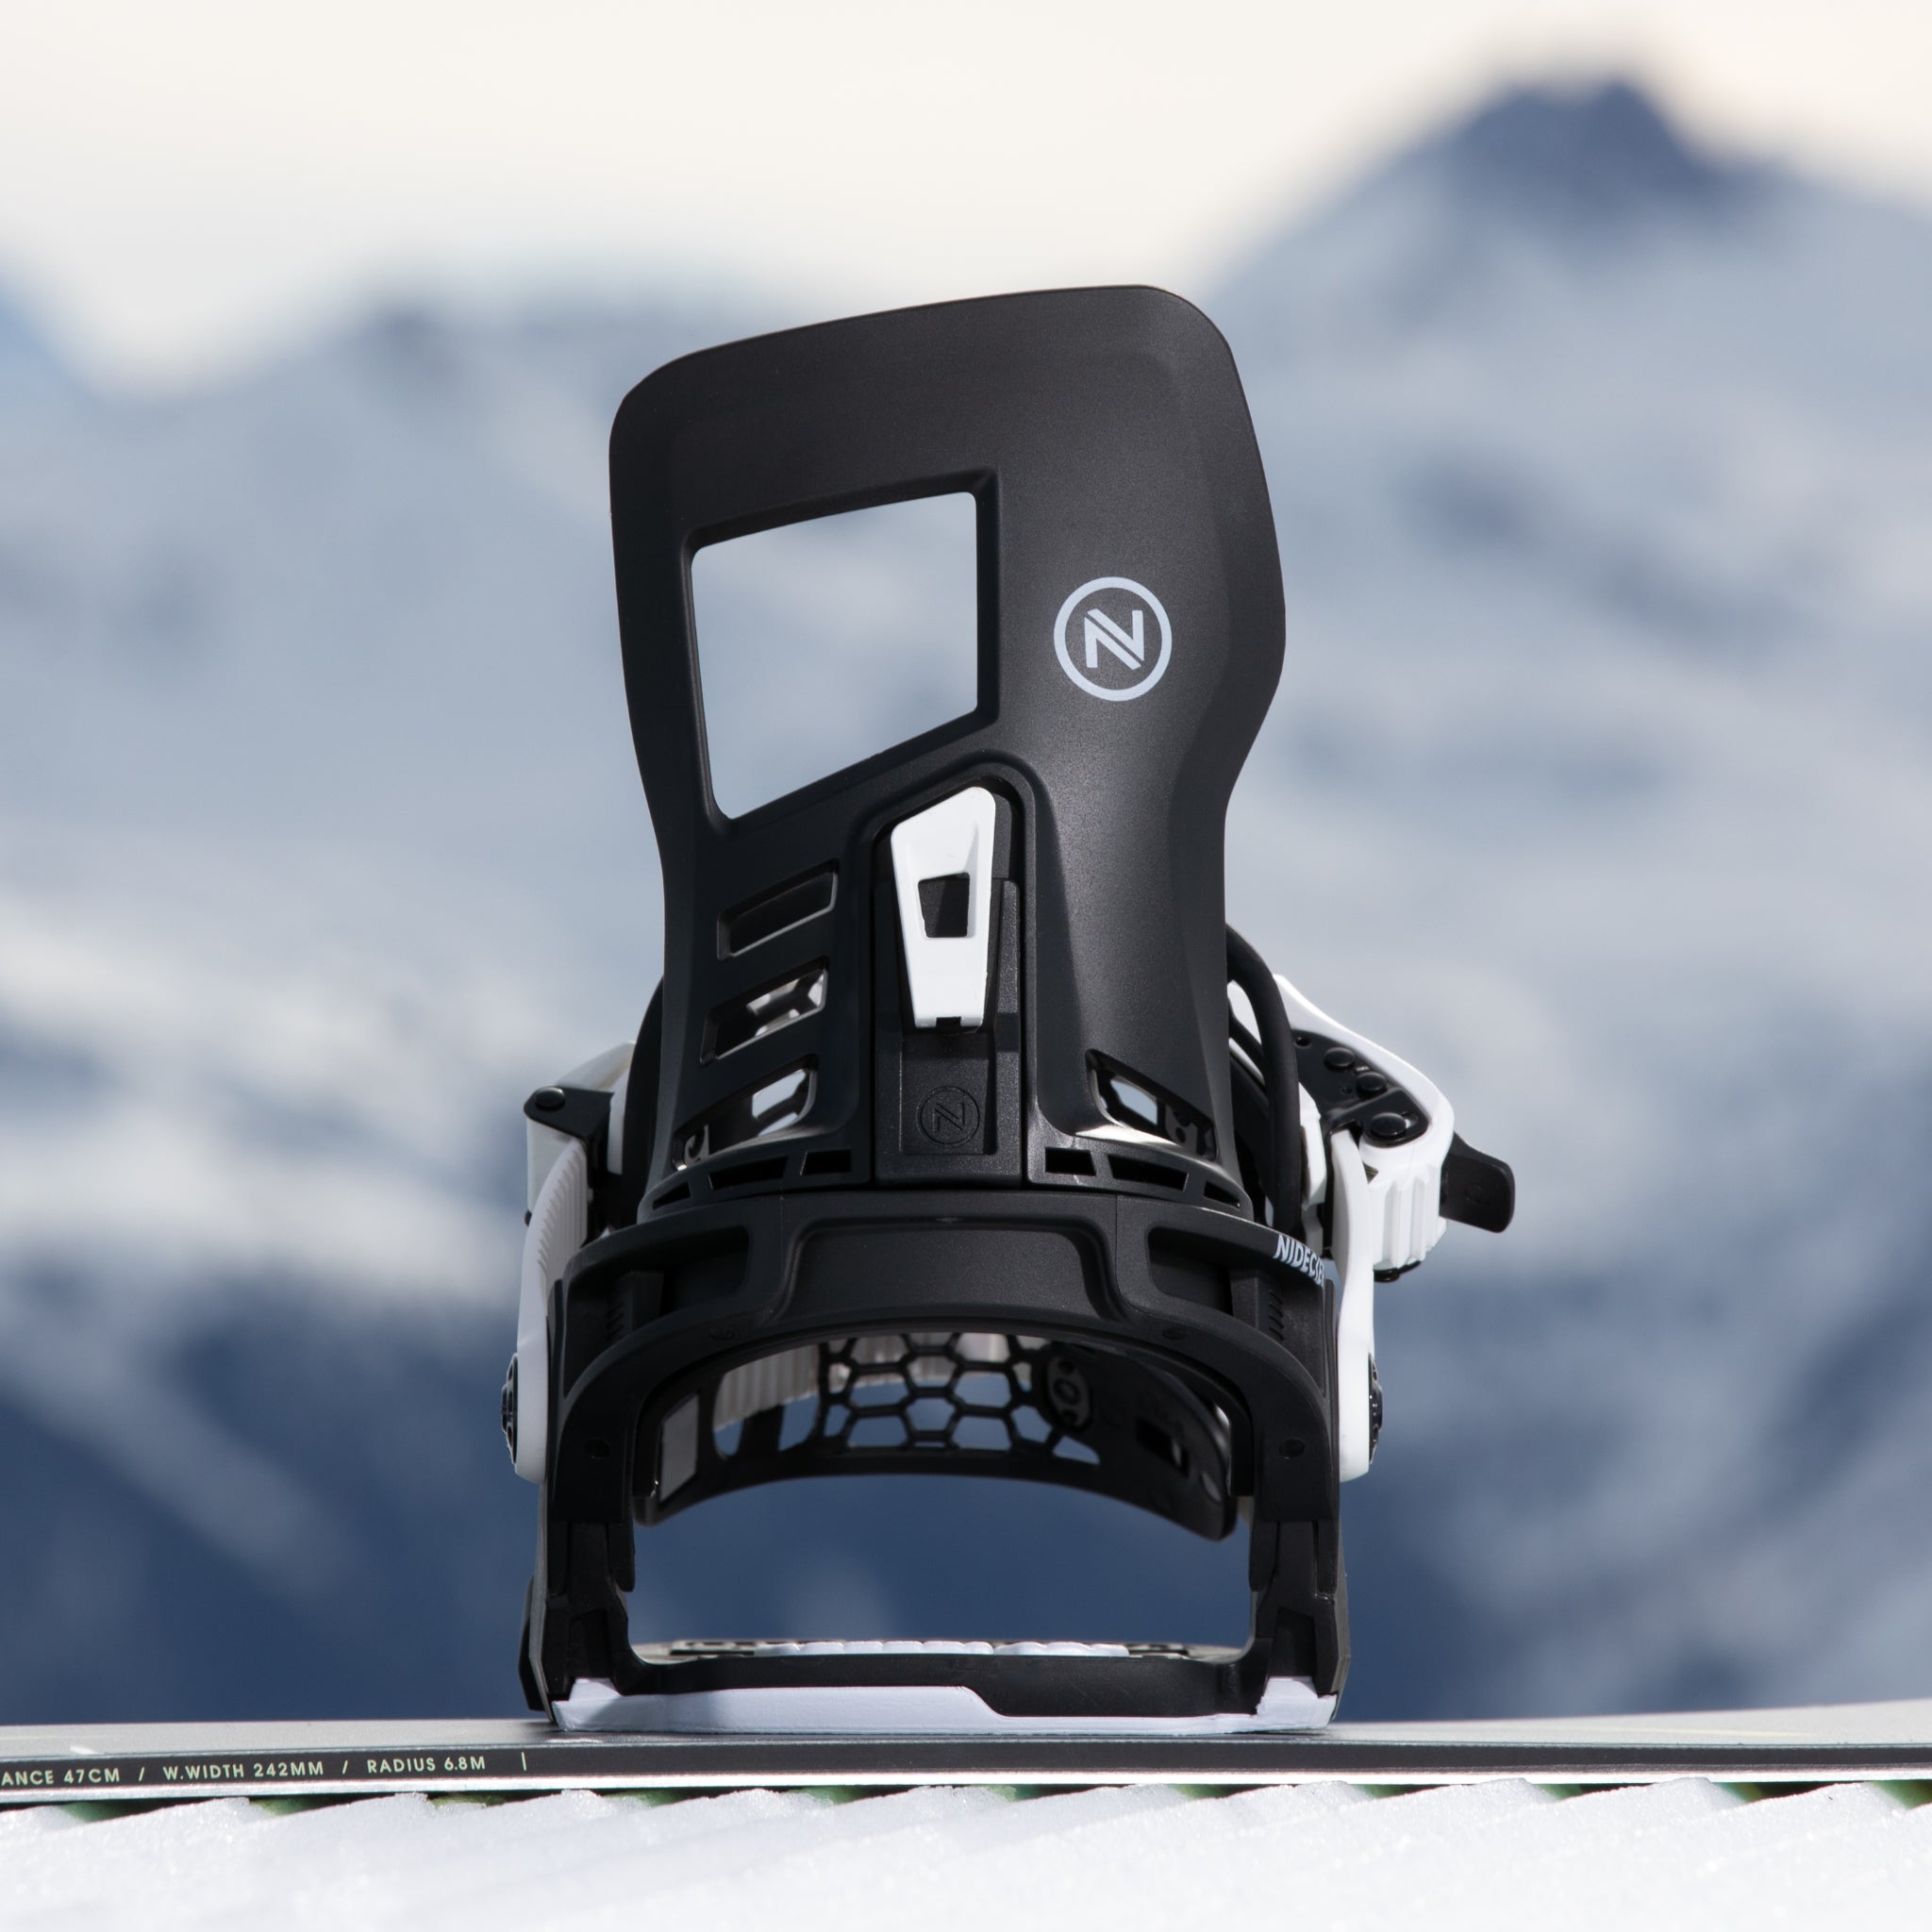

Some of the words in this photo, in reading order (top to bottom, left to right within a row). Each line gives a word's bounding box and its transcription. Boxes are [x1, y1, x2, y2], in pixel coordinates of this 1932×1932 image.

[1, 1770, 55, 1787] ANCE
[63, 1768, 121, 1784] 47CM
[162, 1763, 244, 1781] W.WIDTH
[253, 1760, 324, 1778] 242MM
[366, 1757, 436, 1774] RADIUS
[443, 1756, 486, 1772] 6.8M
